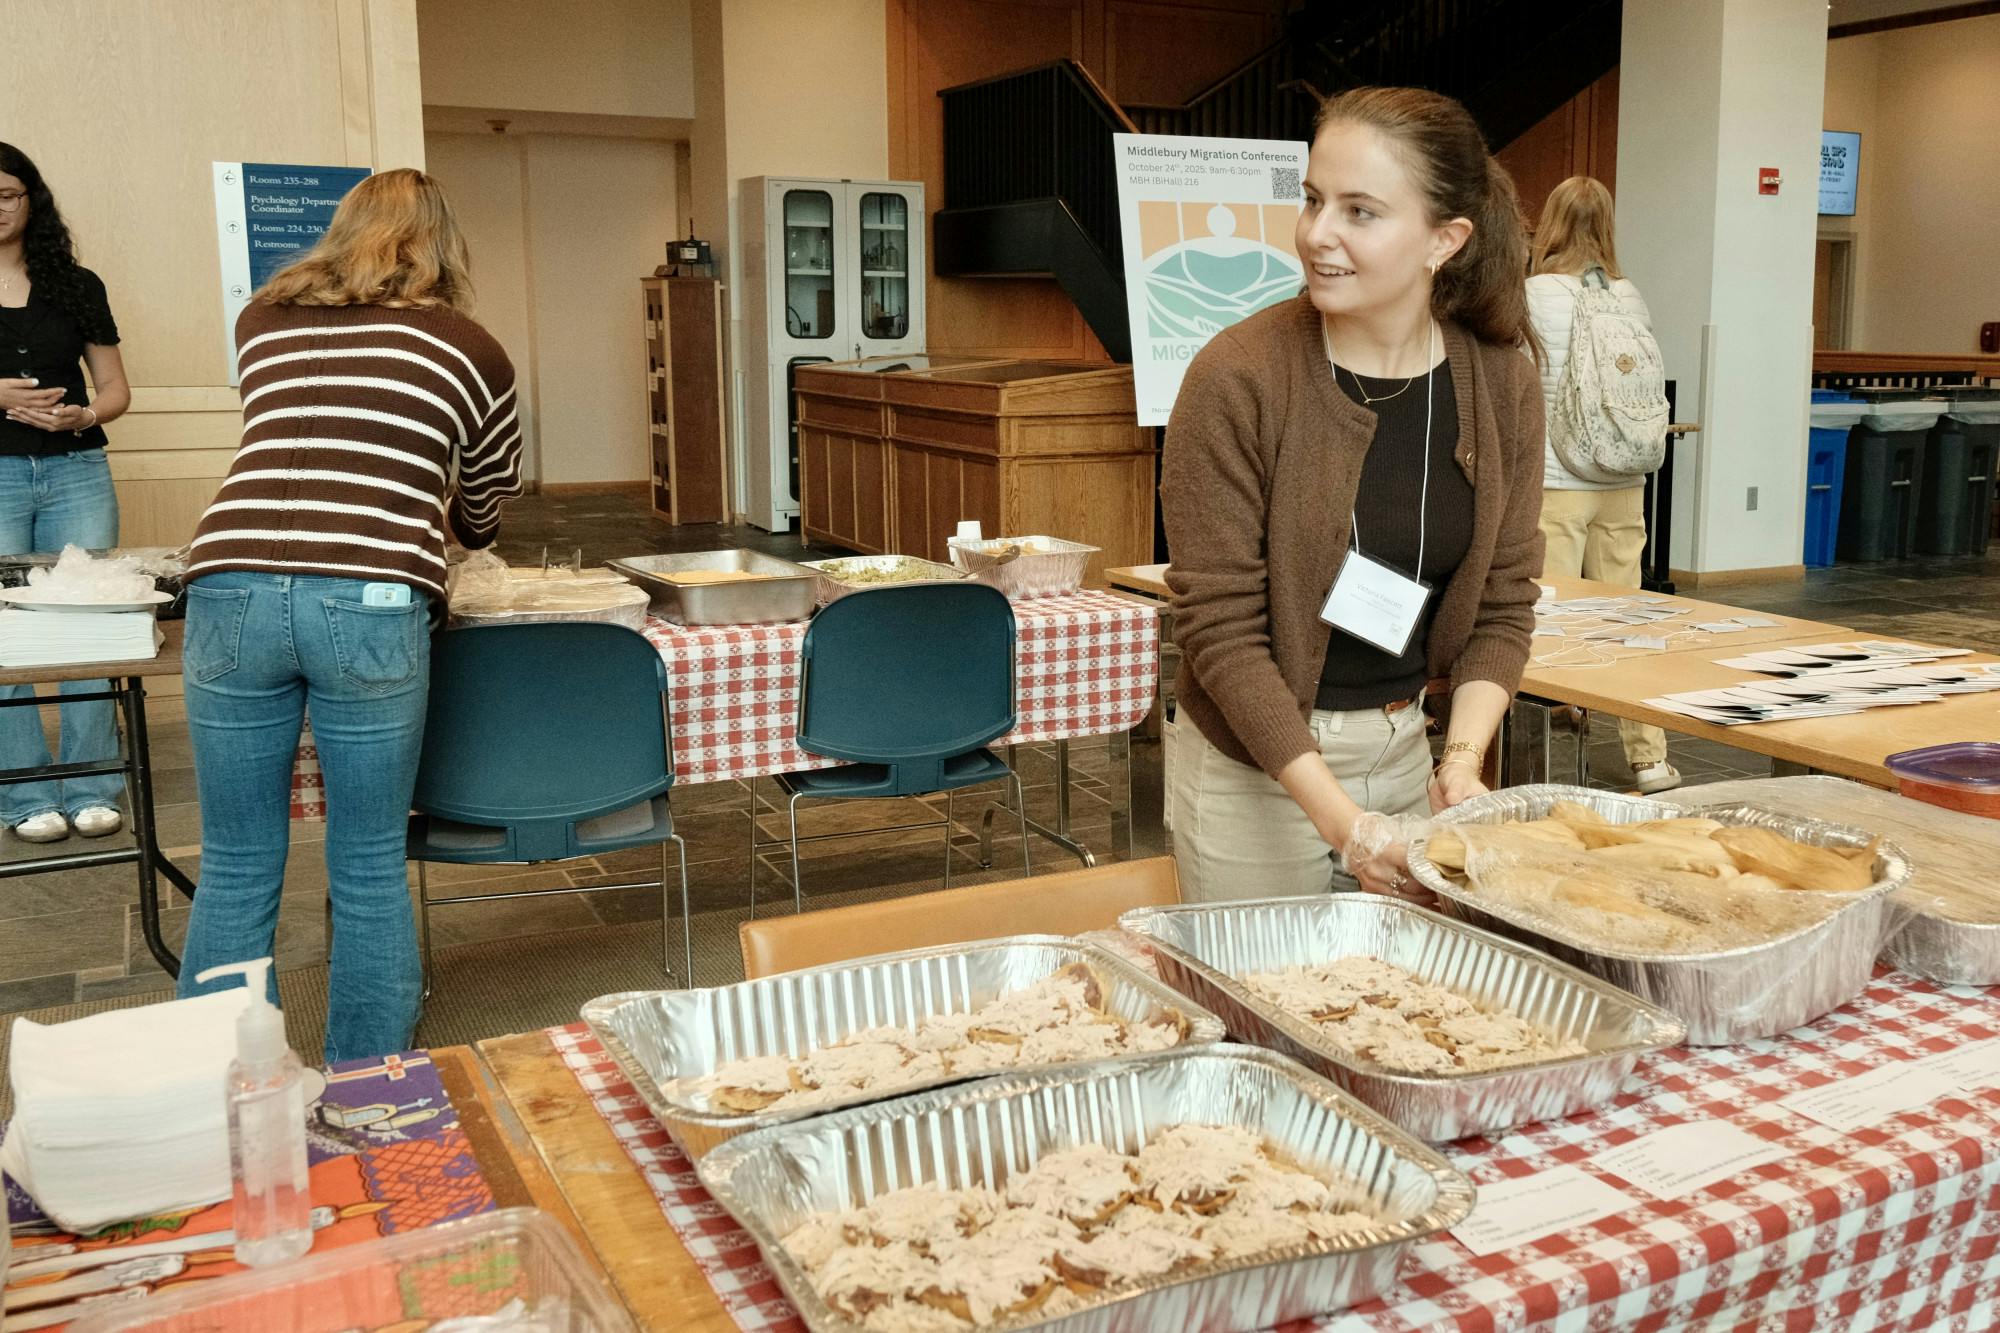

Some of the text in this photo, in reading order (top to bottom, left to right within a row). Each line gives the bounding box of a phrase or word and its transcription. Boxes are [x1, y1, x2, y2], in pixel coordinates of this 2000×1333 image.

[1127, 146, 1298, 162] Middlebury Migration Conference
[1128, 162, 1163, 172] October
[250, 175, 319, 186] Rooms 235-288
[1129, 176, 1151, 185] MBH
[1184, 177, 1200, 186] 216
[251, 195, 299, 207] Psychology
[251, 204, 305, 214] Coordinator
[253, 224, 285, 233] Rooms
[287, 225, 306, 234] 224,
[255, 240, 300, 249] Restrooms
